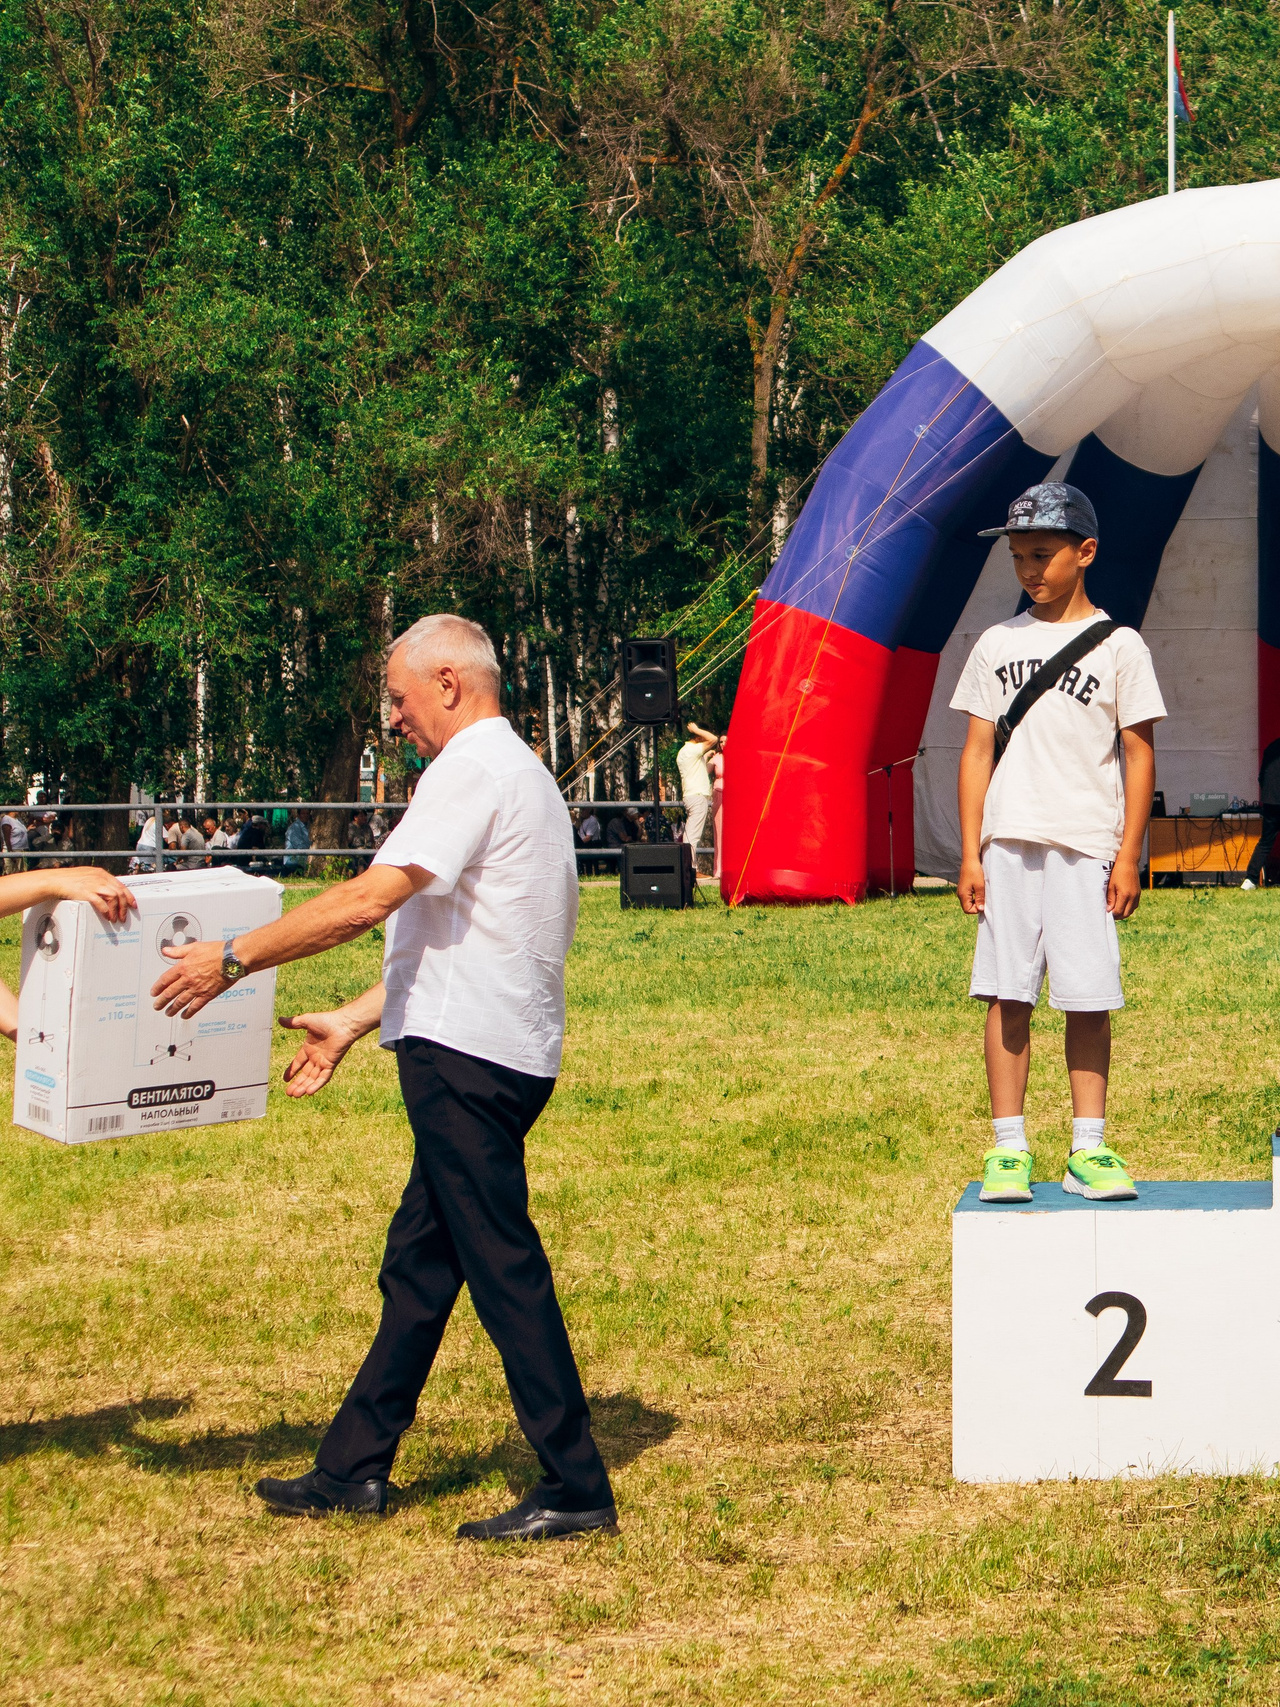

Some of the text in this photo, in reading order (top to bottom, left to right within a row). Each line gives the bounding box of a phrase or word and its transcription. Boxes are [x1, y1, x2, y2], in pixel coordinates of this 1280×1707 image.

[994, 658, 1101, 707] FUTRE
[217, 987, 256, 1000] орости
[108, 1011, 123, 1020] 110
[131, 1084, 212, 1106] ВЕНТИЛЯТОР
[140, 1103, 200, 1121] НАПОЛЬНЫЙ
[1083, 1290, 1153, 1398] 2
